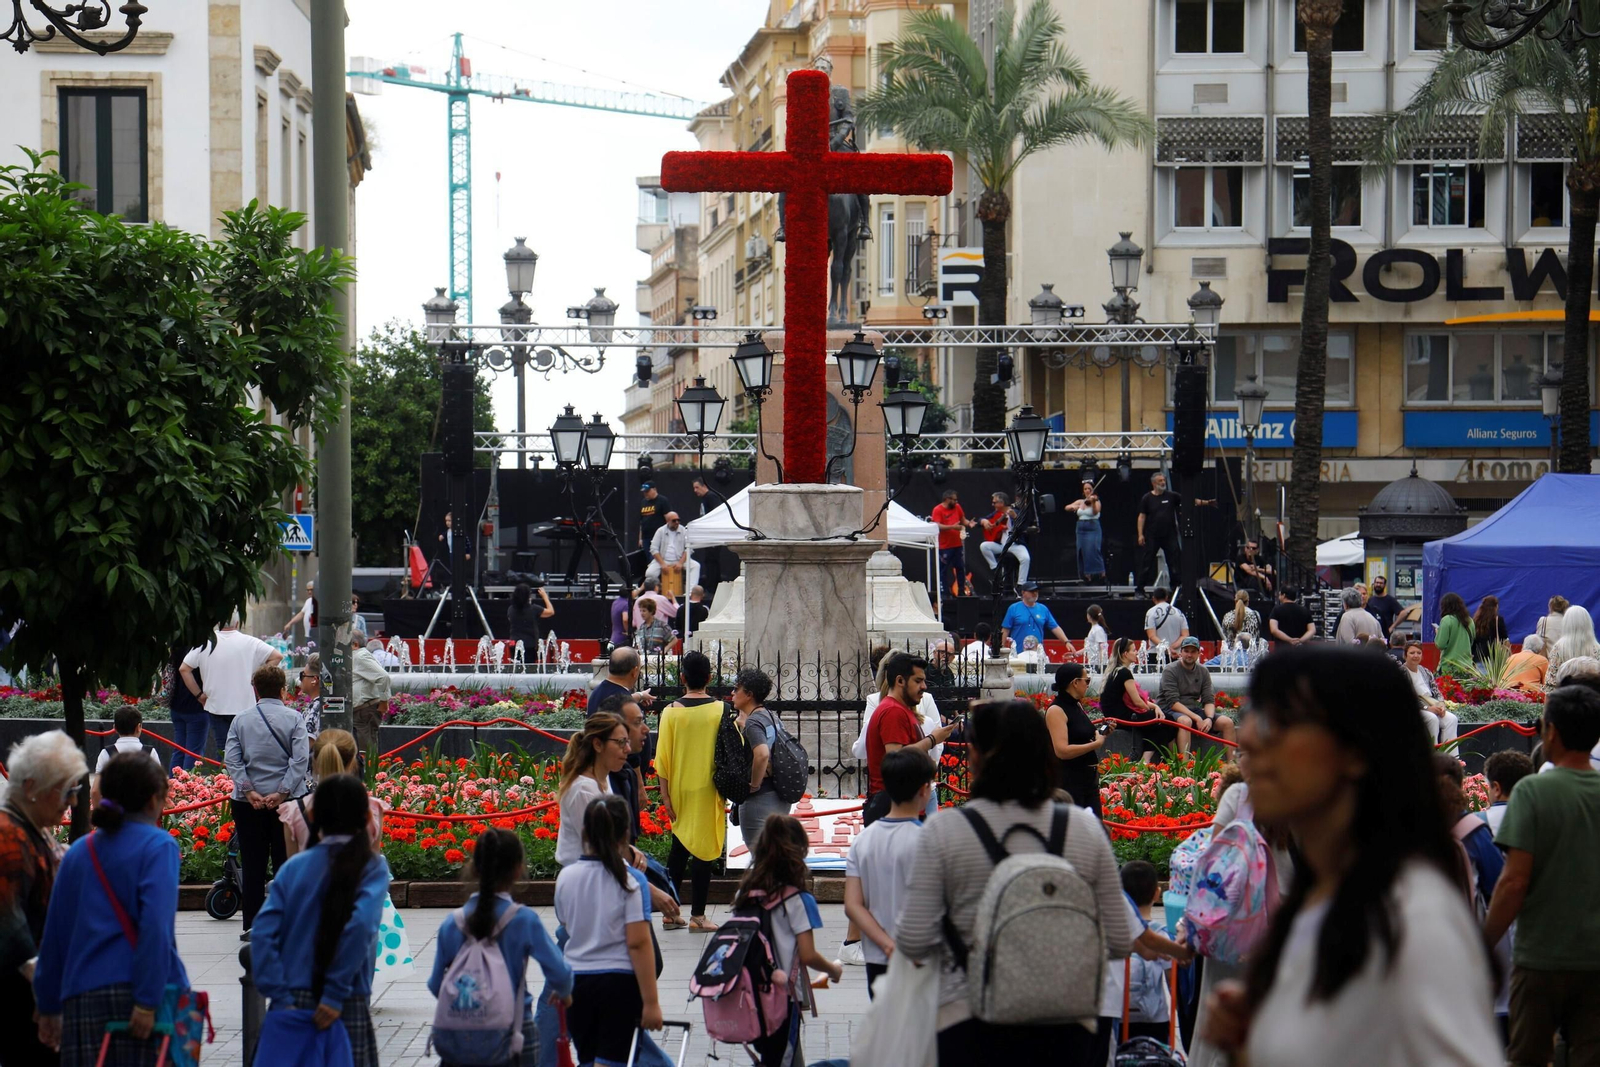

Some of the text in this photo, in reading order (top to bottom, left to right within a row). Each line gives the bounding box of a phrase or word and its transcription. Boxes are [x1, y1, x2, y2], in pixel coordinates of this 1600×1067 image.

[1467, 428, 1537, 440] Allianz Seguros
[1455, 455, 1559, 481] Aroma
